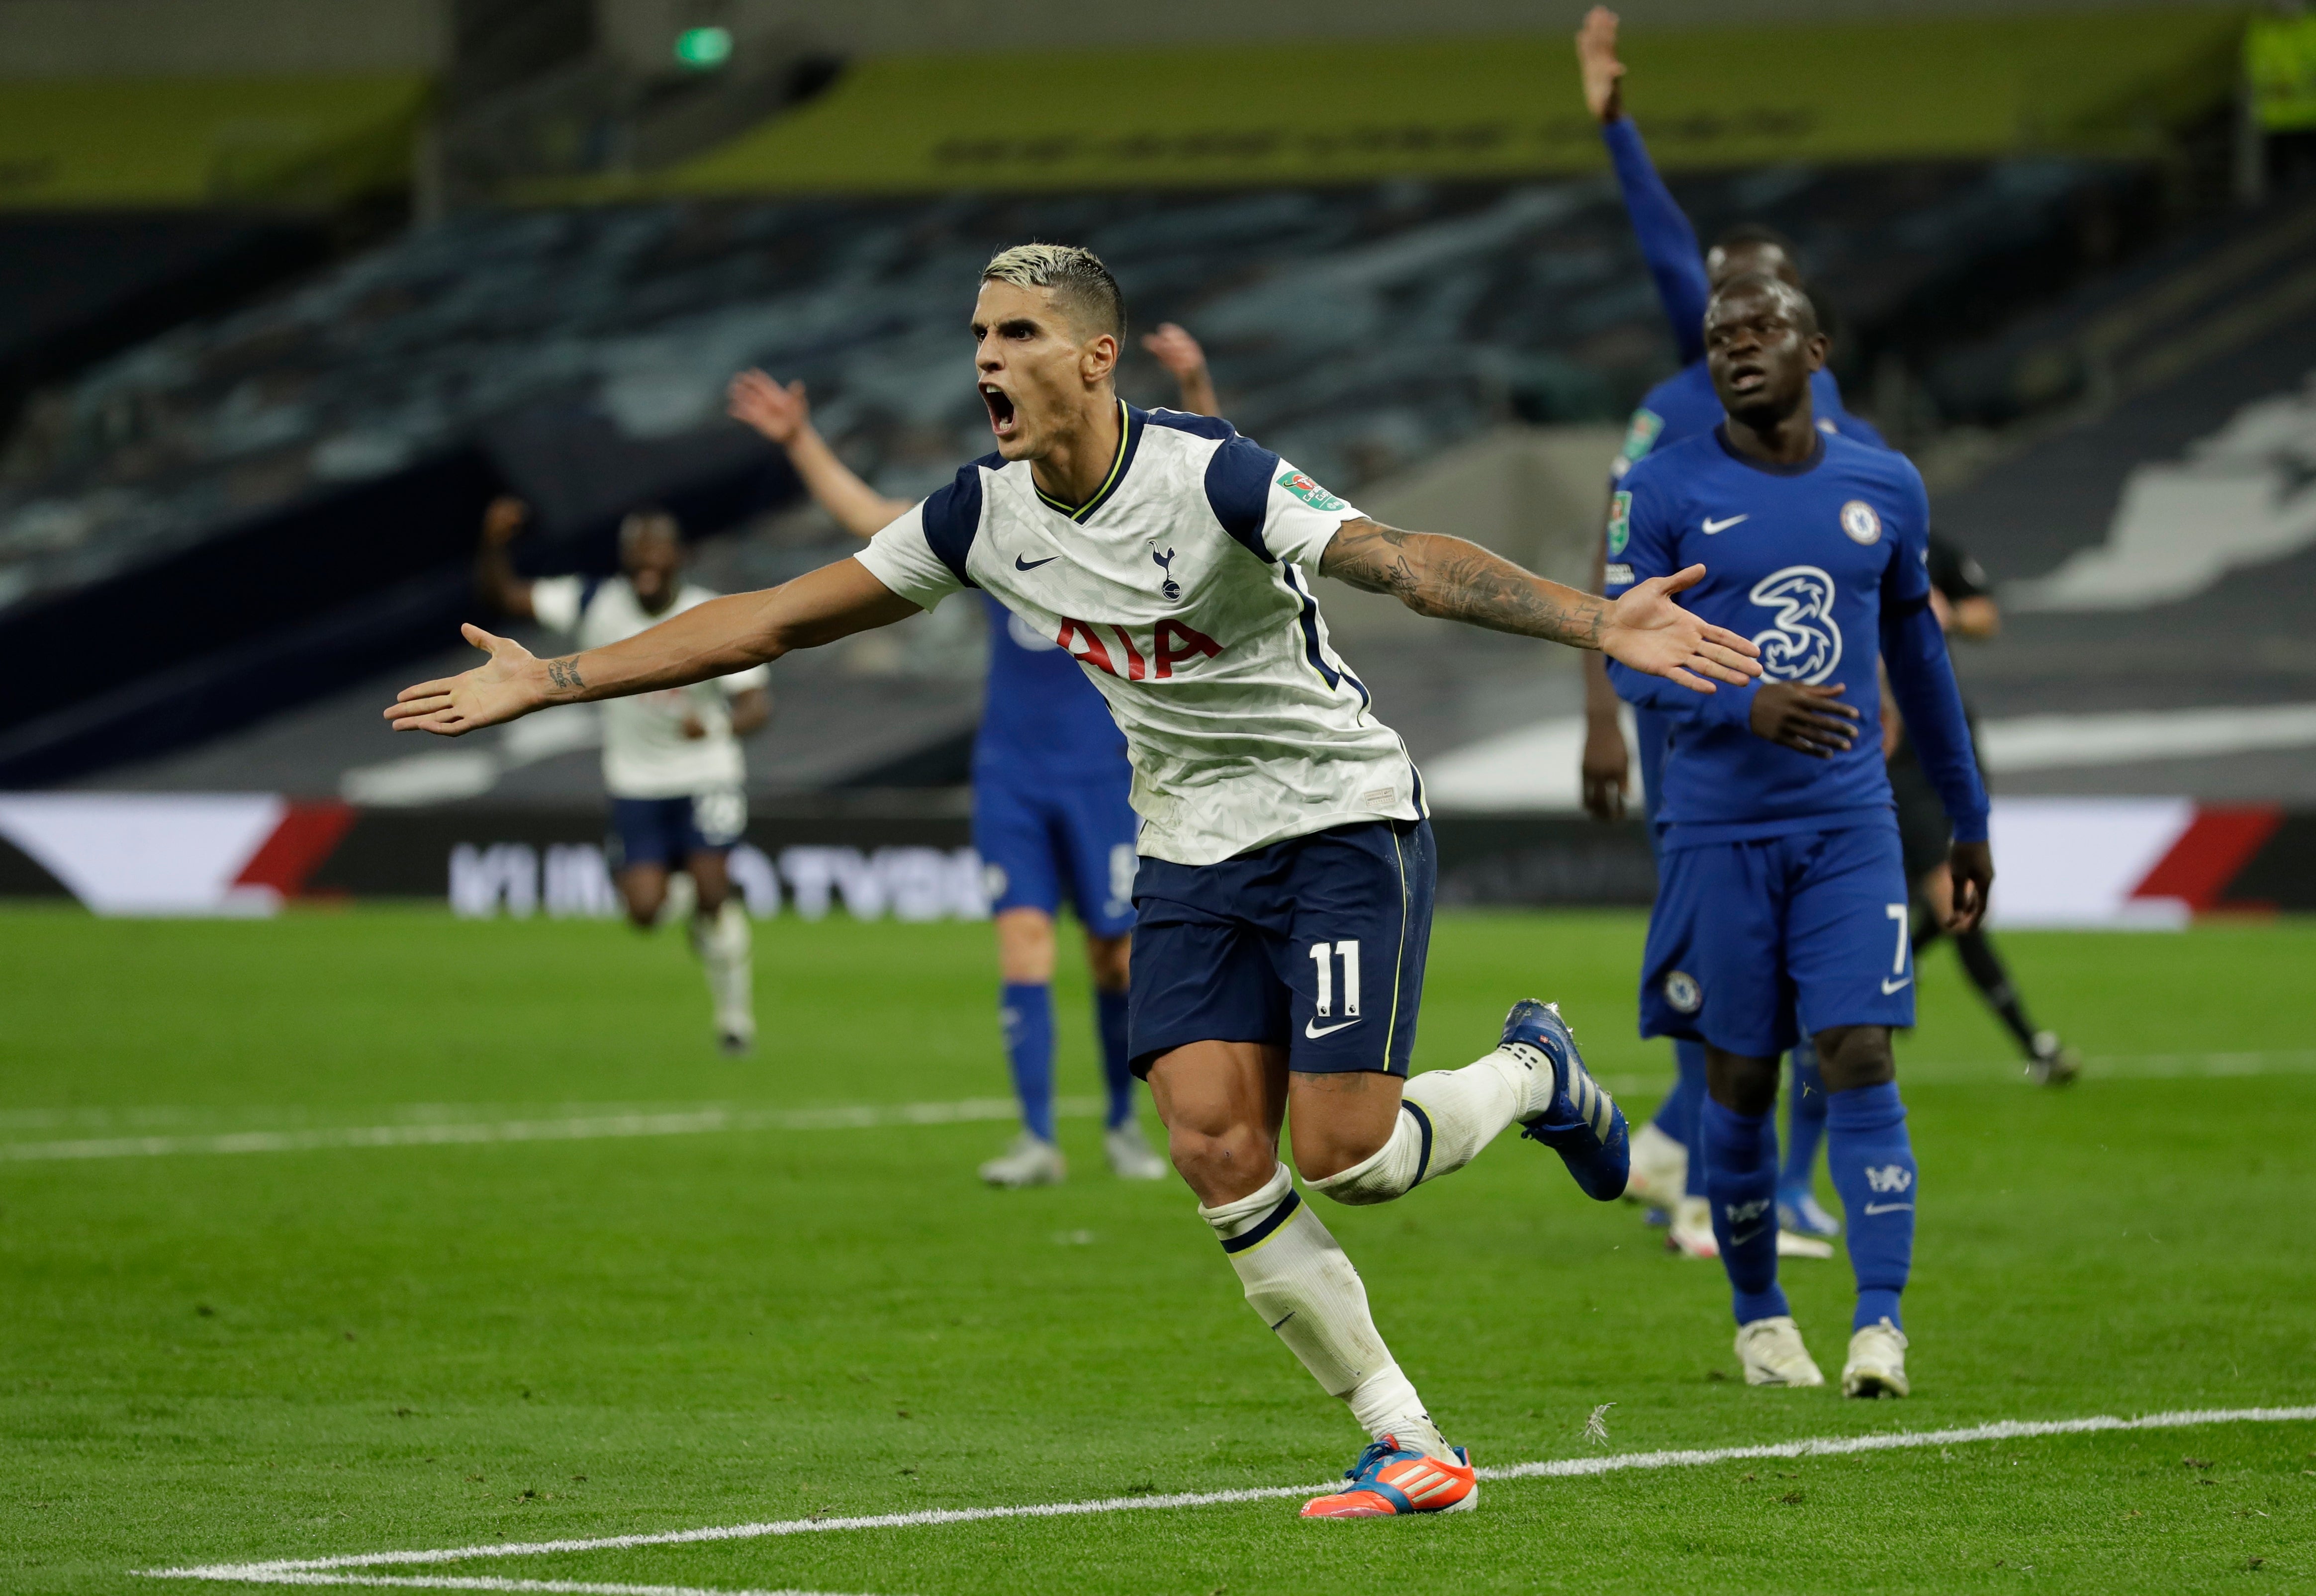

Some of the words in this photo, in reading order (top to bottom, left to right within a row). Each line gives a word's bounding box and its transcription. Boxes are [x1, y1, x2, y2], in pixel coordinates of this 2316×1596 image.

[1057, 617, 1224, 681] AIA
[1886, 903, 1908, 975] 7
[1309, 940, 1361, 1017] 11
